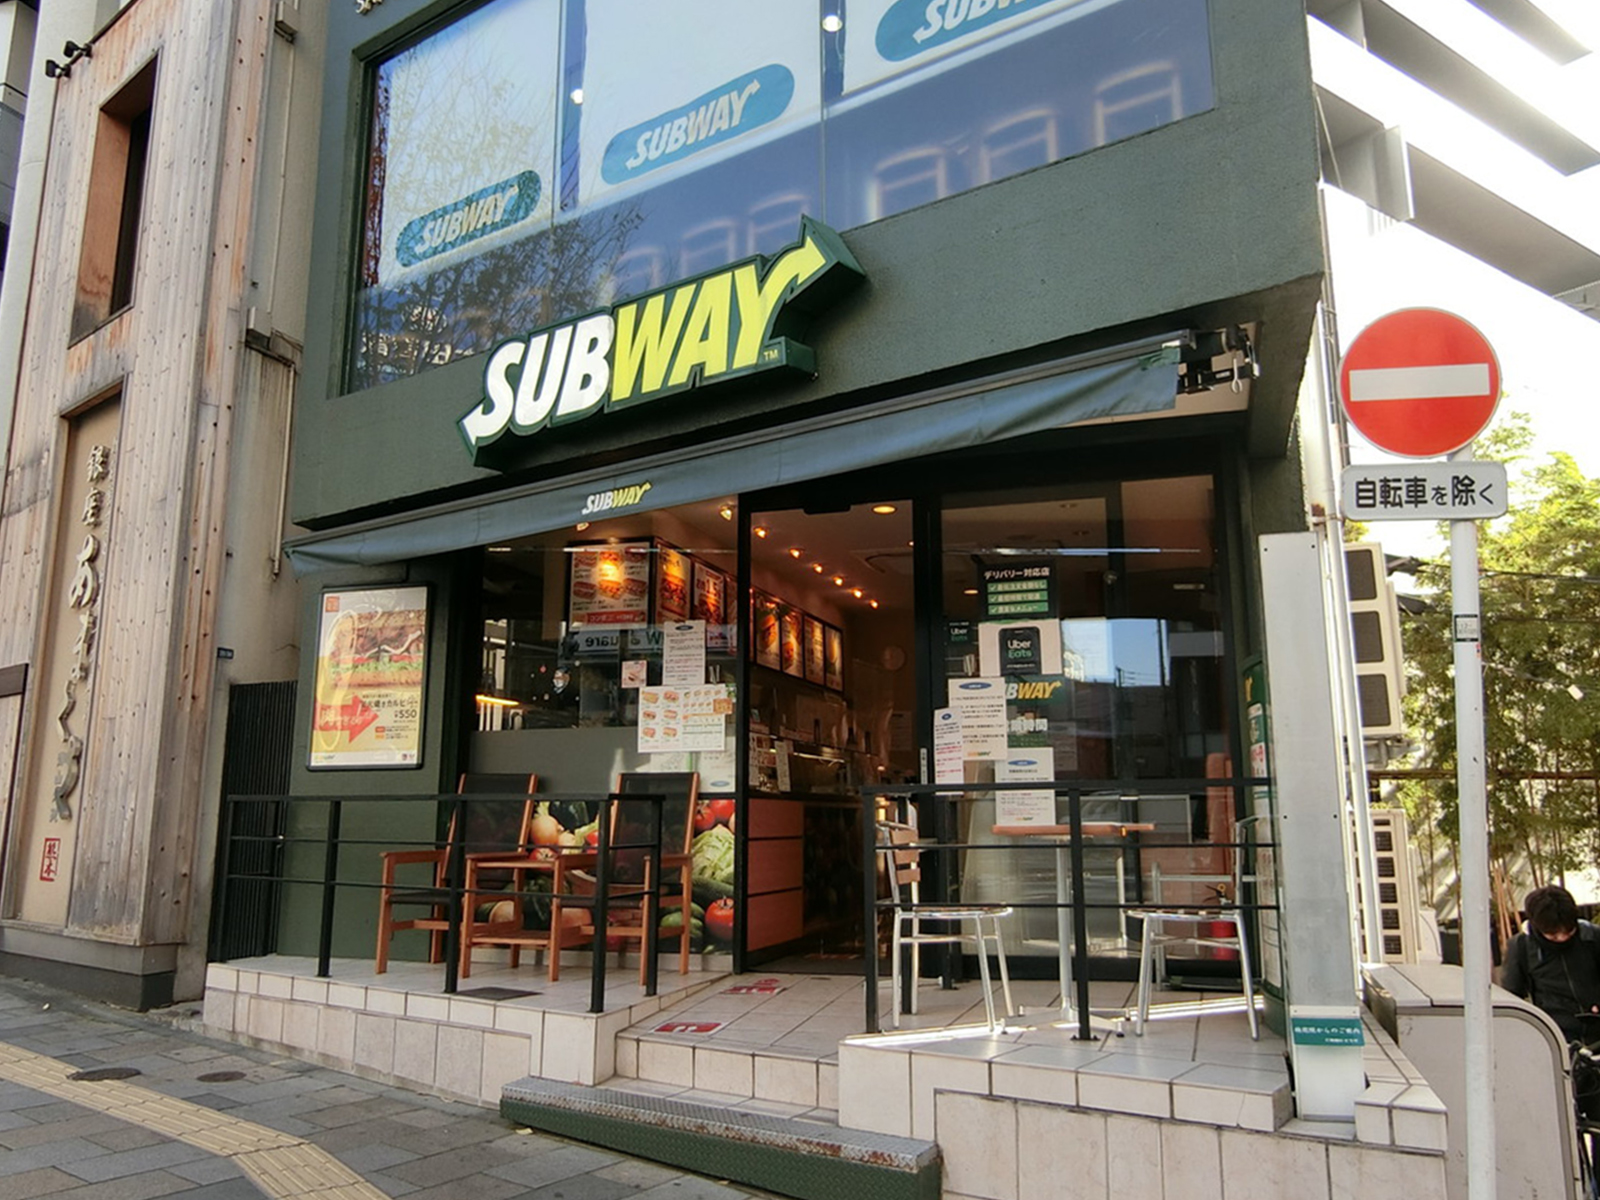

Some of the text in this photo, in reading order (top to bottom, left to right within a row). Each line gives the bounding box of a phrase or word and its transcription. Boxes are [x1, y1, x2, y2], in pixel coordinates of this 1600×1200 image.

[626, 79, 760, 170] SUBWAY
[413, 184, 520, 255] SUBWAY
[462, 235, 828, 442] SUBWAY
[581, 482, 652, 515] SUBWAY
[1355, 474, 1494, 509] 自転車を除く
[983, 567, 1050, 580] デリバリー対応店
[1007, 639, 1032, 649] Uber
[1008, 649, 1032, 658] Eats
[1006, 681, 1062, 700] BWAY
